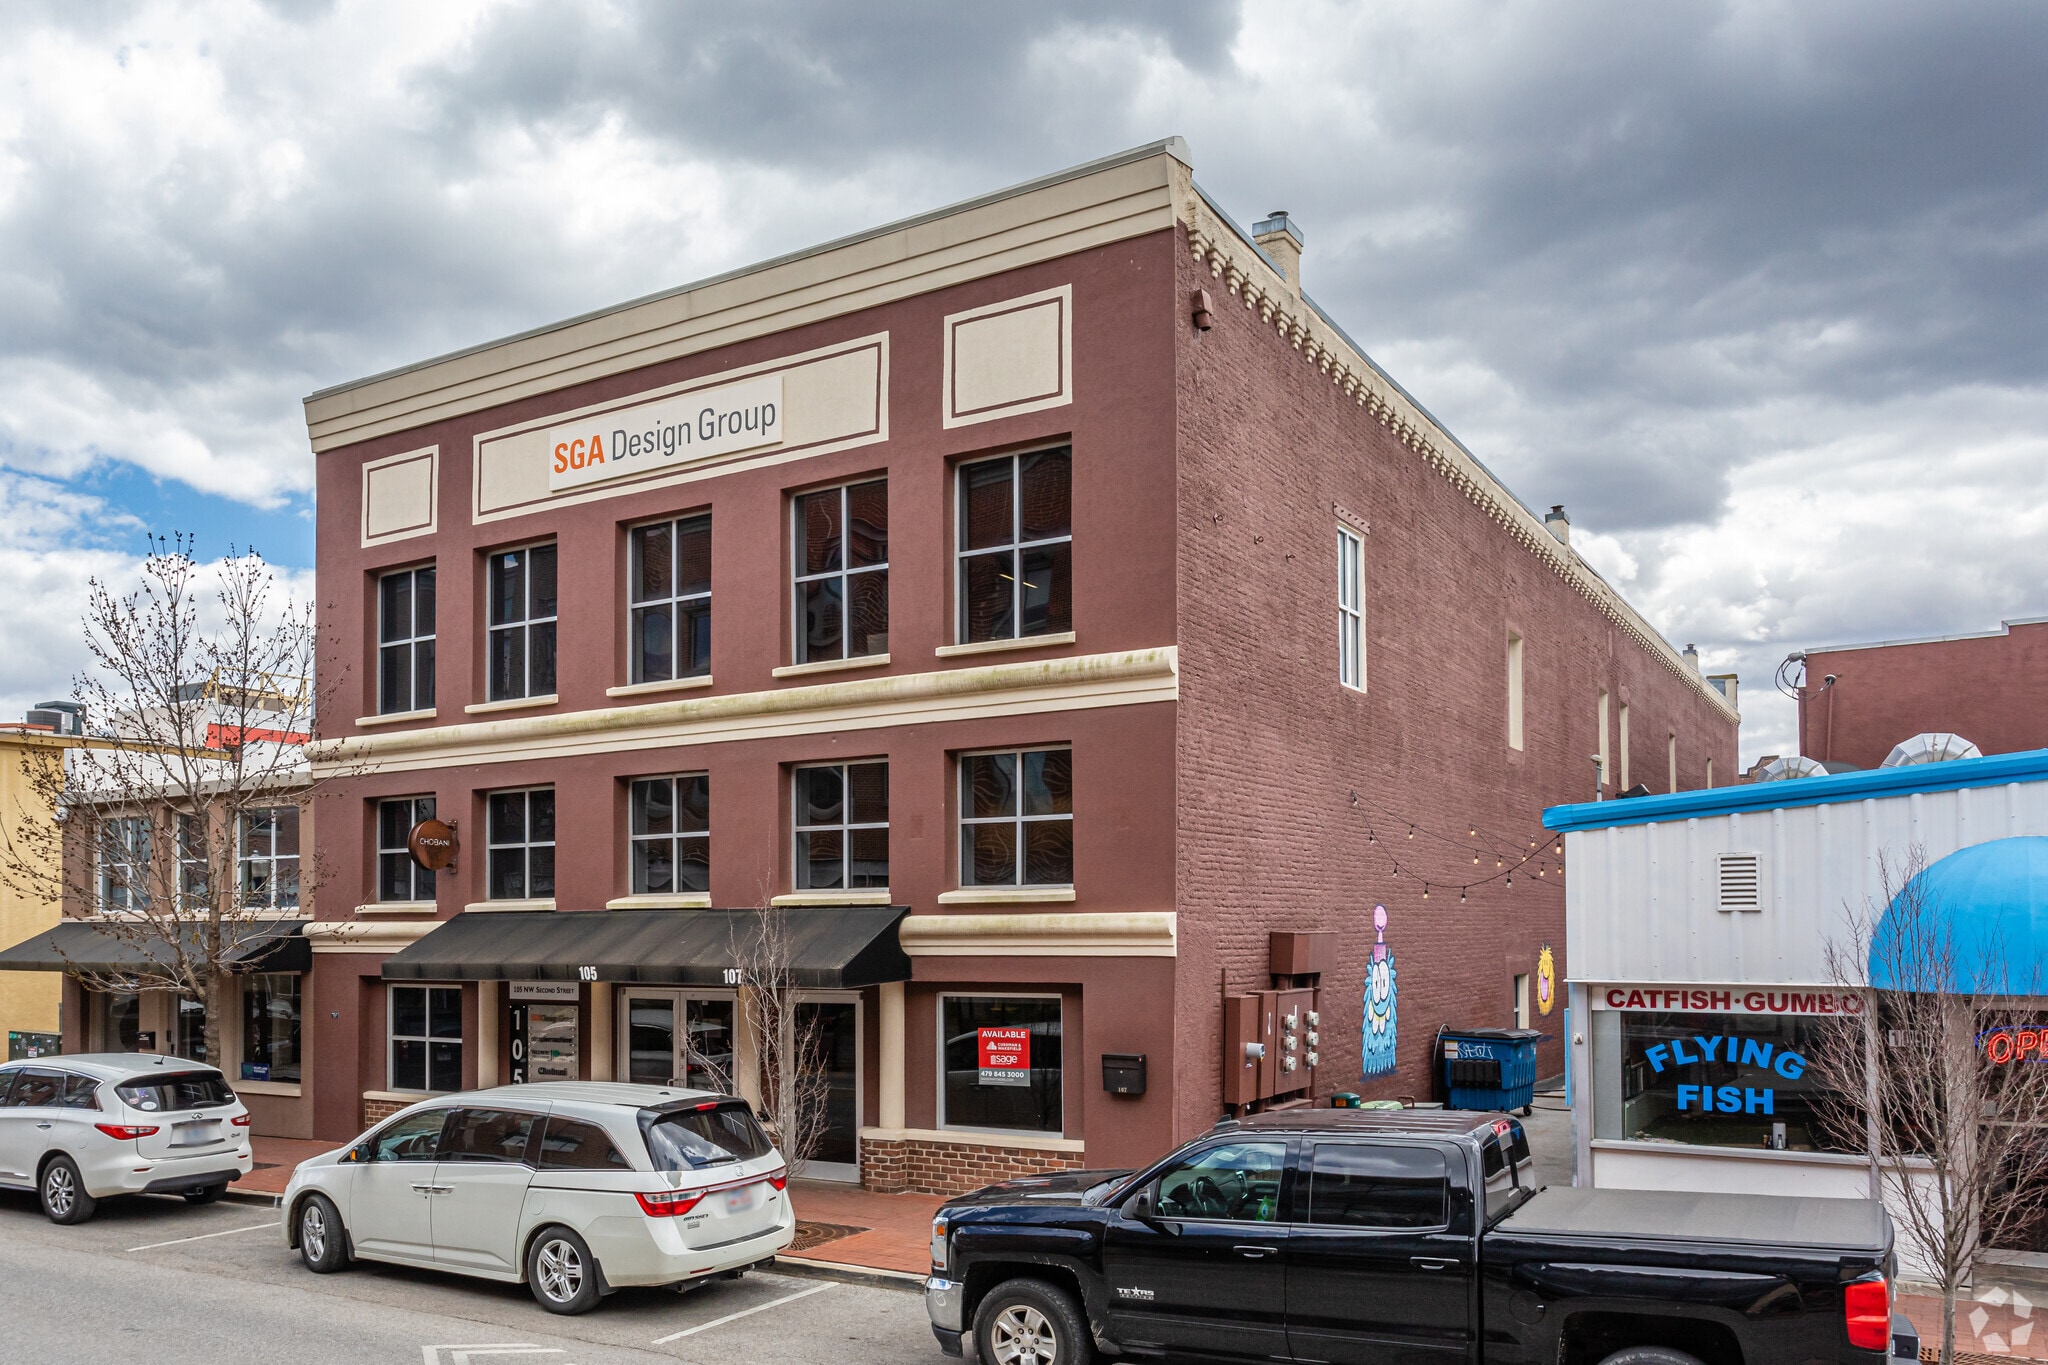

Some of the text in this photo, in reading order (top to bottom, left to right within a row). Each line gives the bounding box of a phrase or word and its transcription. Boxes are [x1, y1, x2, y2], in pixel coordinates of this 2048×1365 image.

[554, 402, 776, 474] SGA Design Group
[420, 837, 450, 847] CHOBANI
[578, 966, 598, 981] 105
[722, 968, 742, 984] 107
[1606, 989, 1864, 1014] CATFISH GUMBO
[982, 1030, 1026, 1039] AVAILABLE
[996, 1055, 1018, 1065] sage
[1645, 1035, 1807, 1080] FLYING
[1677, 1084, 1774, 1115] FISH
